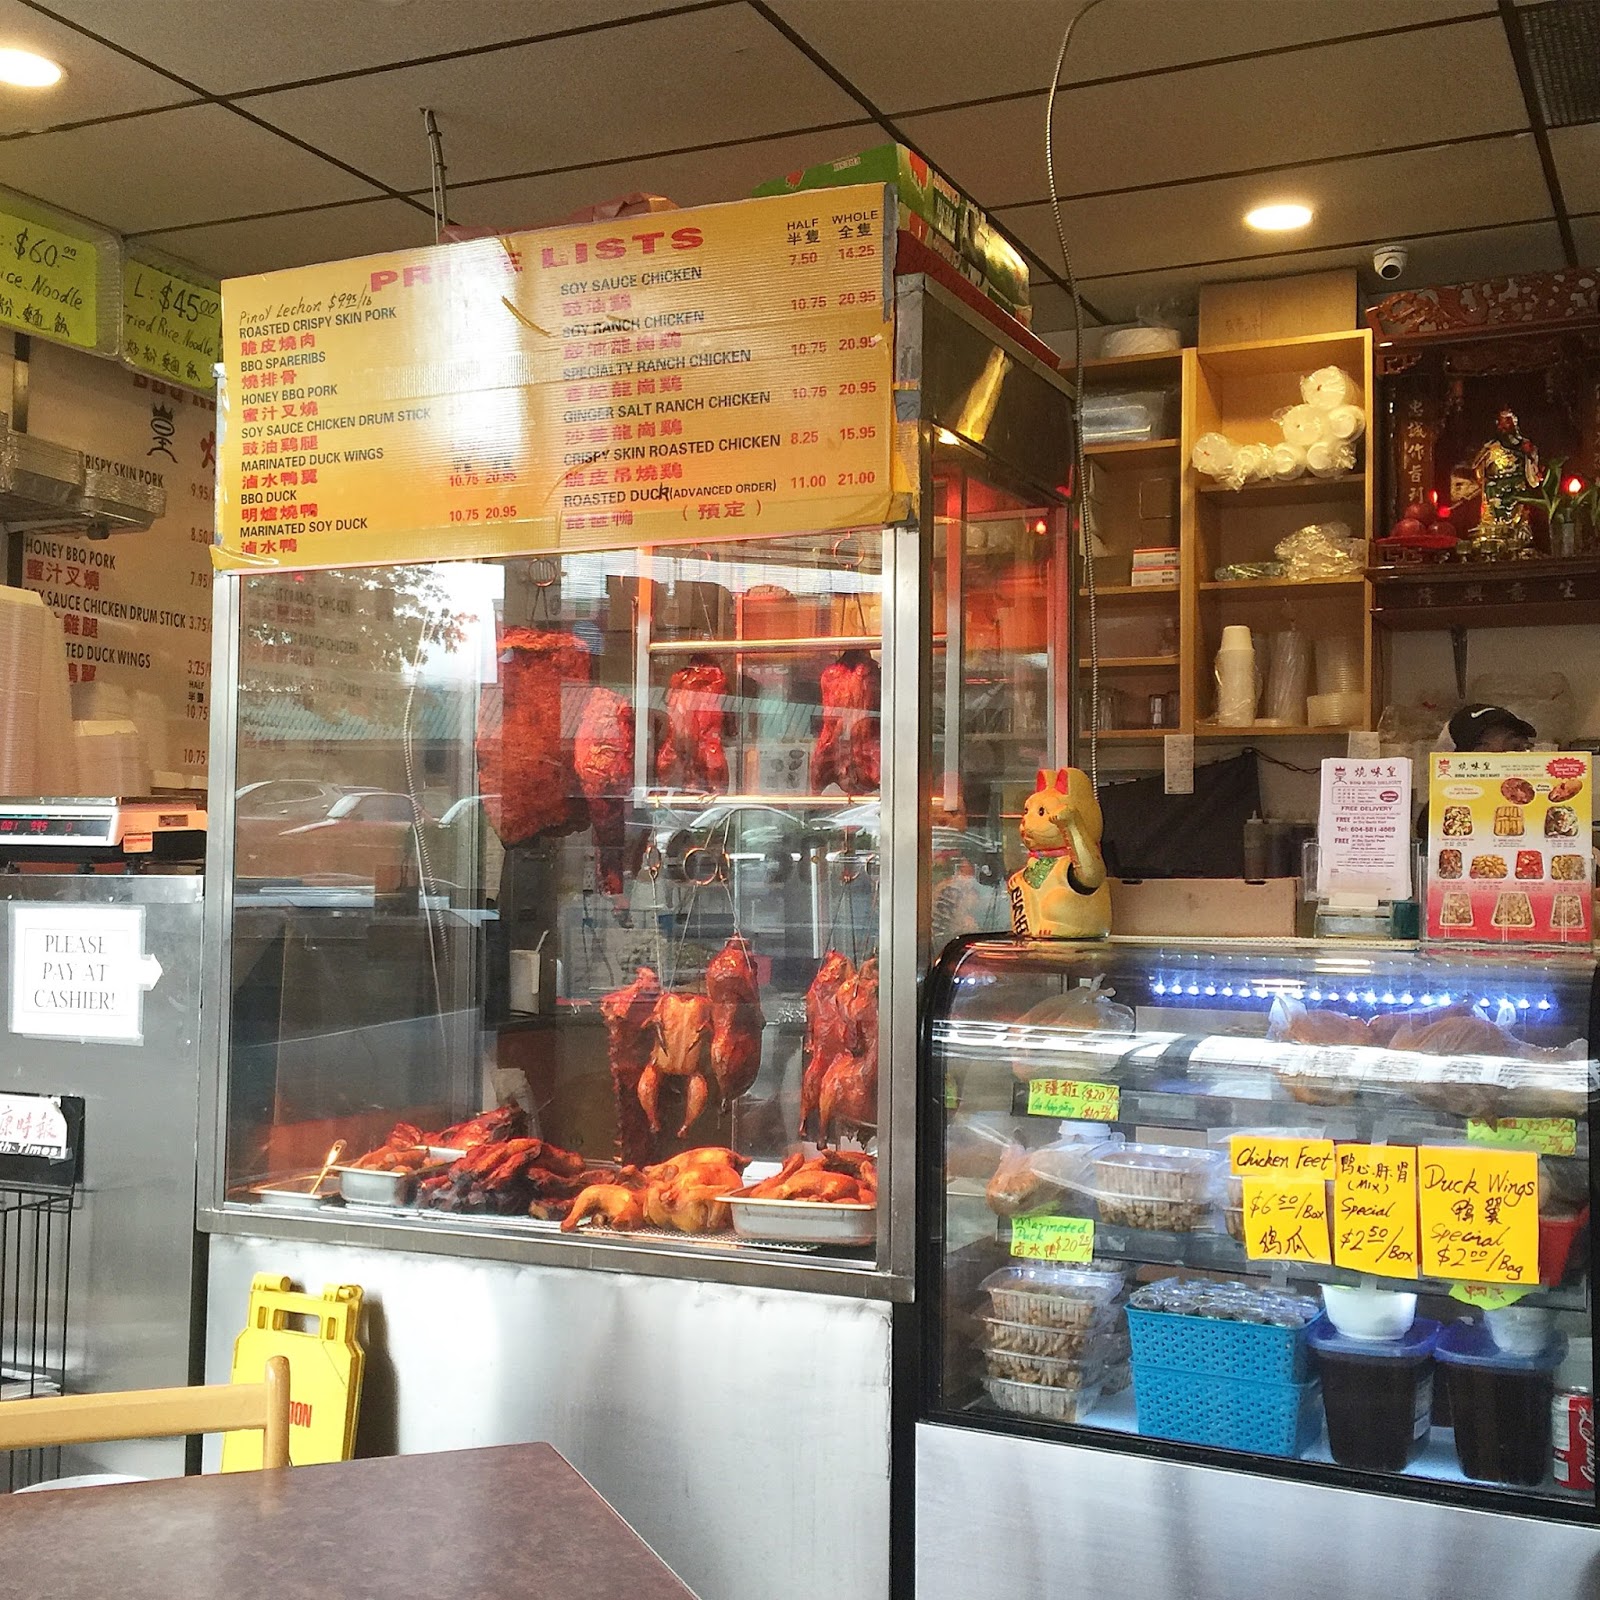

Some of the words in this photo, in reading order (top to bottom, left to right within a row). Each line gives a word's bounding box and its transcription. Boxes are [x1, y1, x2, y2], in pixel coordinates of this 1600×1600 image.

[787, 218, 819, 231] HALF
[831, 210, 879, 225] WHOLE
[839, 223, 872, 239] 全隻
[370, 252, 522, 293] PRE
[541, 227, 704, 268] LISTS
[561, 283, 587, 296] SOY
[592, 275, 637, 291] SAUCE
[641, 267, 702, 285] CHICKEN
[239, 320, 290, 338] ROASTED
[293, 317, 331, 332] CRISPY
[335, 312, 362, 326] SKIN
[365, 307, 397, 322] PORK
[593, 320, 640, 334] RANCH
[644, 311, 704, 329] CHICKEN
[241, 332, 315, 356] 脆皮燒肉
[241, 359, 263, 373] BBQ
[265, 352, 326, 369] SPARERIBS
[563, 362, 633, 380] SPECIALTY
[637, 356, 685, 373] RANCH
[689, 349, 751, 367] CHICKEN
[242, 370, 297, 390] 燒排骨
[839, 381, 876, 395] 20.95
[241, 392, 279, 405] HONEY
[282, 388, 305, 401] BBQ
[308, 384, 337, 397] PORK
[618, 402, 652, 418] SALT
[656, 398, 704, 413] RANCH
[708, 391, 770, 408] CHICKEN
[243, 401, 318, 423] 蜜汁叉燒
[241, 426, 264, 439] SOY
[266, 422, 303, 435] SAUCE
[307, 417, 356, 431] CHICKEN
[359, 412, 394, 425] DRUM
[397, 408, 431, 421] STICK
[791, 432, 819, 445] 8.25
[840, 426, 876, 440] 15.95
[241, 456, 306, 472] MARINATED
[310, 451, 340, 466] DUCK
[344, 448, 384, 462] WINGS
[563, 450, 610, 466] CRISPY
[613, 447, 645, 460] SKIN
[649, 441, 714, 457] ROASTED
[718, 434, 781, 451] CHICKEN
[85, 455, 113, 472] RISPY
[114, 462, 137, 479] SKIN
[139, 470, 164, 488] PORK
[790, 475, 826, 489] 11.00
[838, 472, 875, 485] 21.00
[241, 493, 264, 505] BBQ
[266, 490, 297, 503] DUCK
[564, 491, 626, 507] ROASTED
[736, 479, 777, 495] ORDER)
[449, 509, 479, 522] 10.75
[486, 506, 516, 519] 20.95
[240, 524, 306, 538] MARINATED
[308, 522, 331, 533] SOY
[336, 518, 368, 530] DUCK
[25, 539, 64, 558] HONEY
[66, 545, 86, 563] BBQ
[90, 551, 116, 570] PORK
[47, 591, 80, 611] SAUCE
[83, 597, 128, 619] CHICKEN
[130, 606, 157, 623] DRUM
[160, 610, 186, 628] STICK
[87, 647, 115, 663] DUCK
[117, 650, 151, 668] WINGS
[186, 704, 208, 720] 10.75
[184, 749, 206, 764] 10.75
[45, 935, 107, 954] PLEASE
[43, 962, 74, 980] PAY
[86, 964, 109, 981] AT
[34, 990, 115, 1010] CASHIER!
[1236, 1146, 1289, 1168] Chicken
[1296, 1146, 1333, 1171] Feet
[1425, 1164, 1480, 1194] Duck
[1488, 1170, 1535, 1207] Wings
[1341, 1197, 1396, 1220] Special
[1015, 1214, 1087, 1233] Marinated
[1431, 1223, 1511, 1246] Special
[289, 1401, 312, 1428] TION
